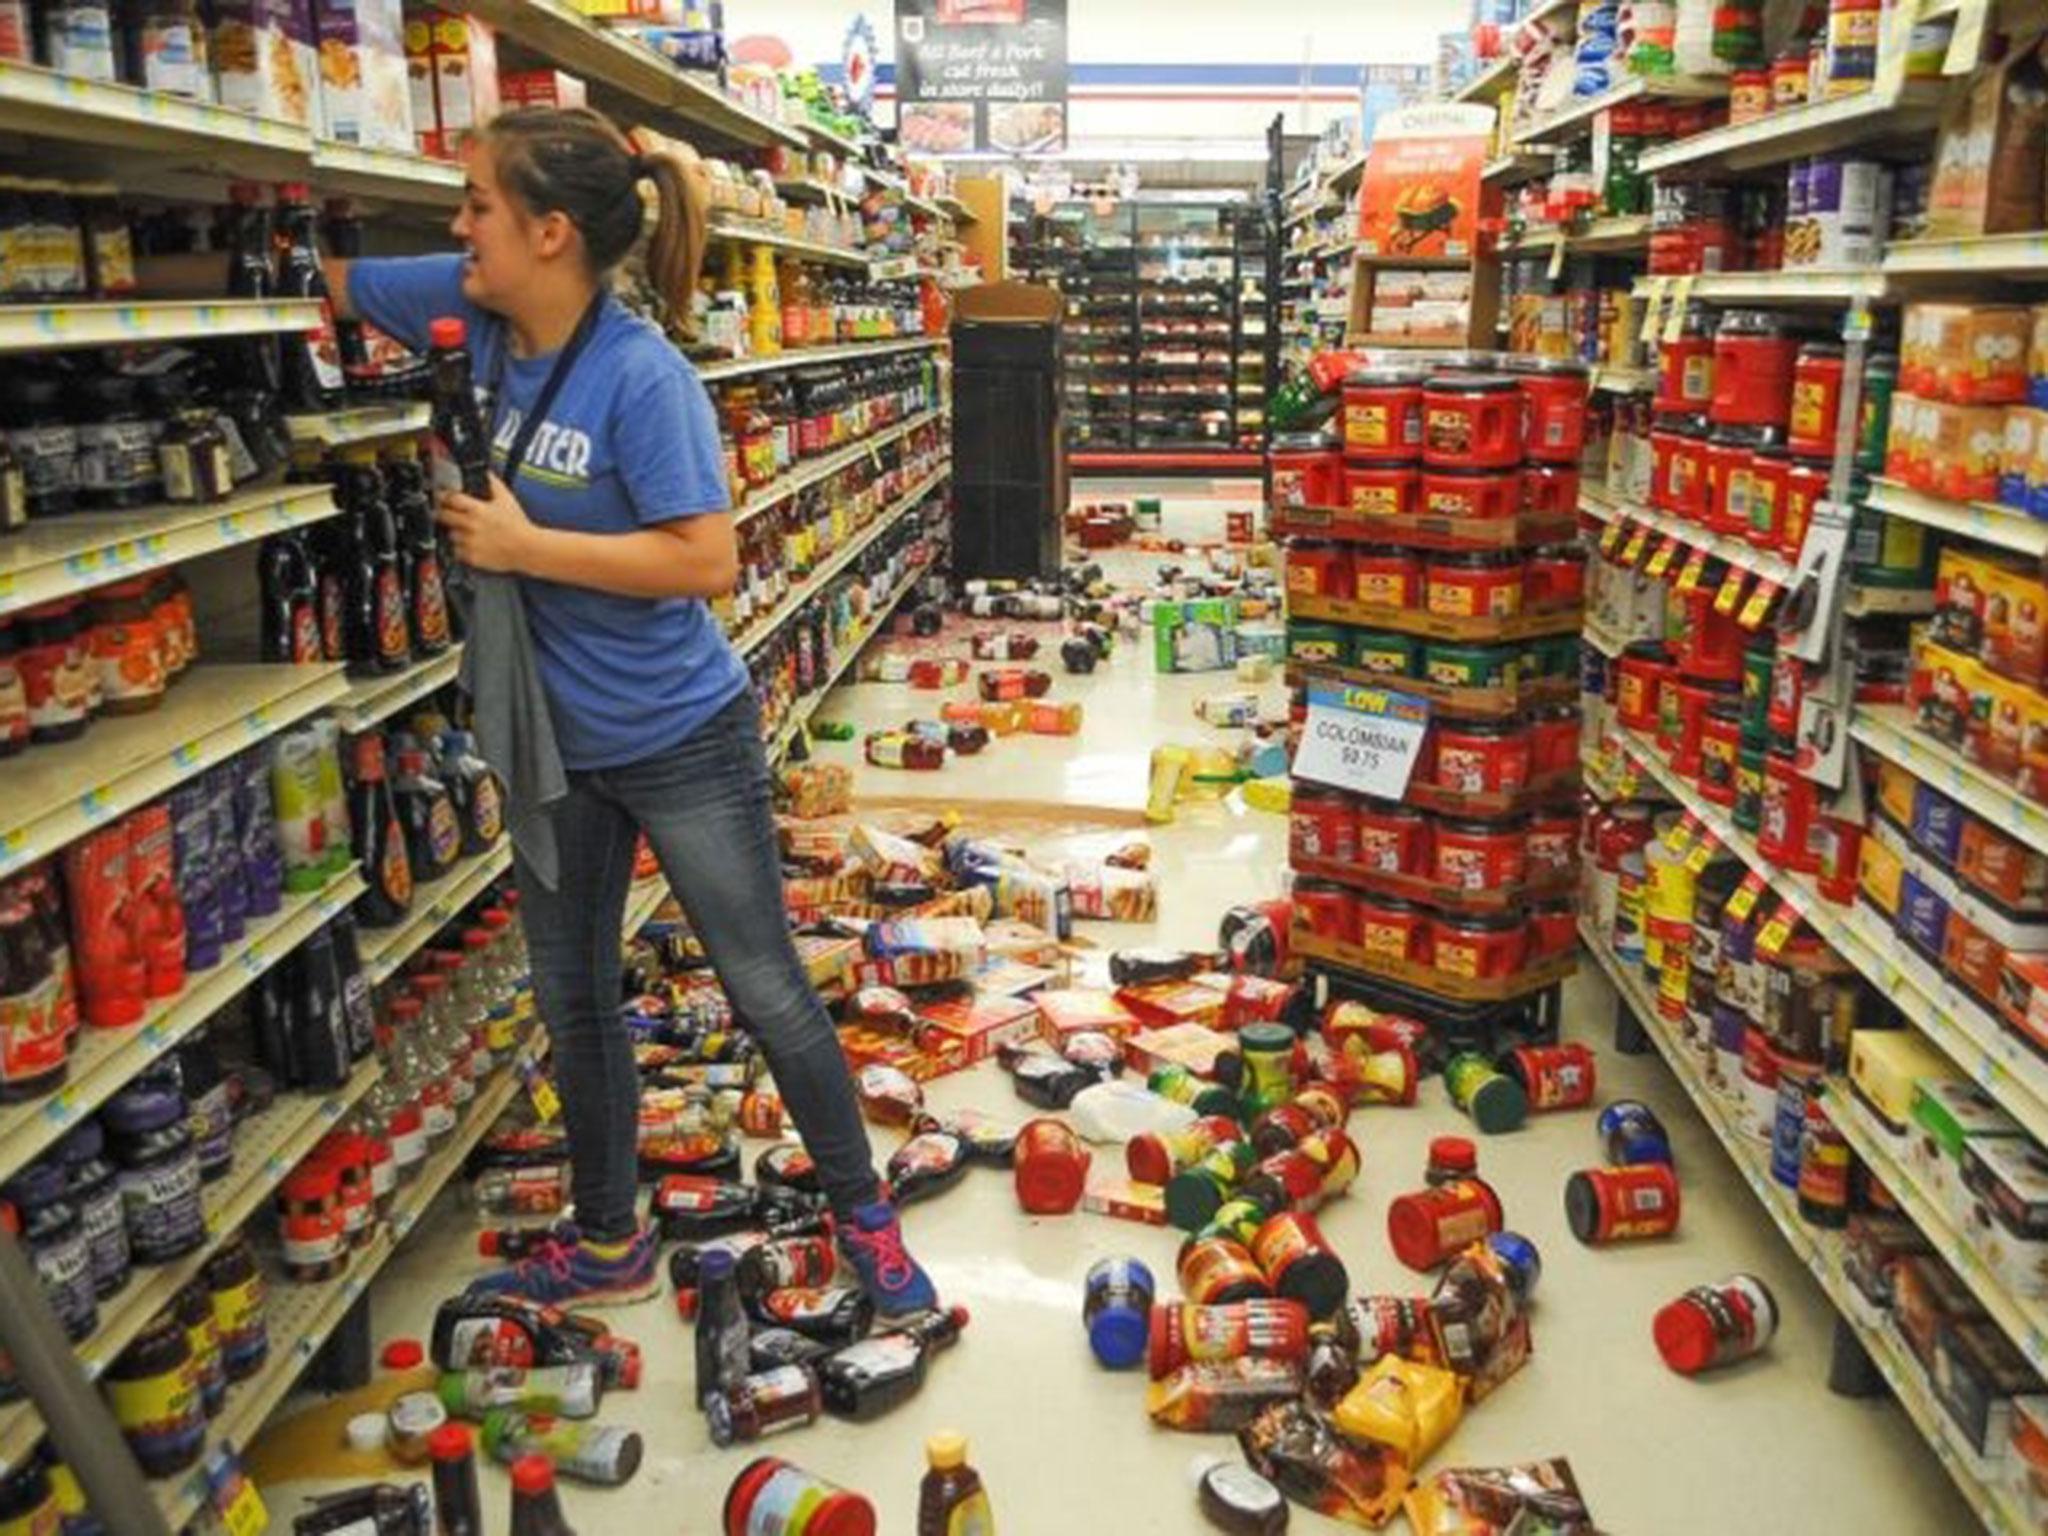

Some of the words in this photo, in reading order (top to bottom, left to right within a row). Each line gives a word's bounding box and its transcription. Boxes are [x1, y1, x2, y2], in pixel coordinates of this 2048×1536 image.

[1004, 43, 1044, 61] Pork
[943, 64, 971, 79] cut
[974, 62, 1020, 80] fresh
[919, 81, 937, 97] in
[940, 82, 983, 97] store
[1344, 687, 1389, 715] LOW
[1315, 720, 1409, 754] COLOMBIAN
